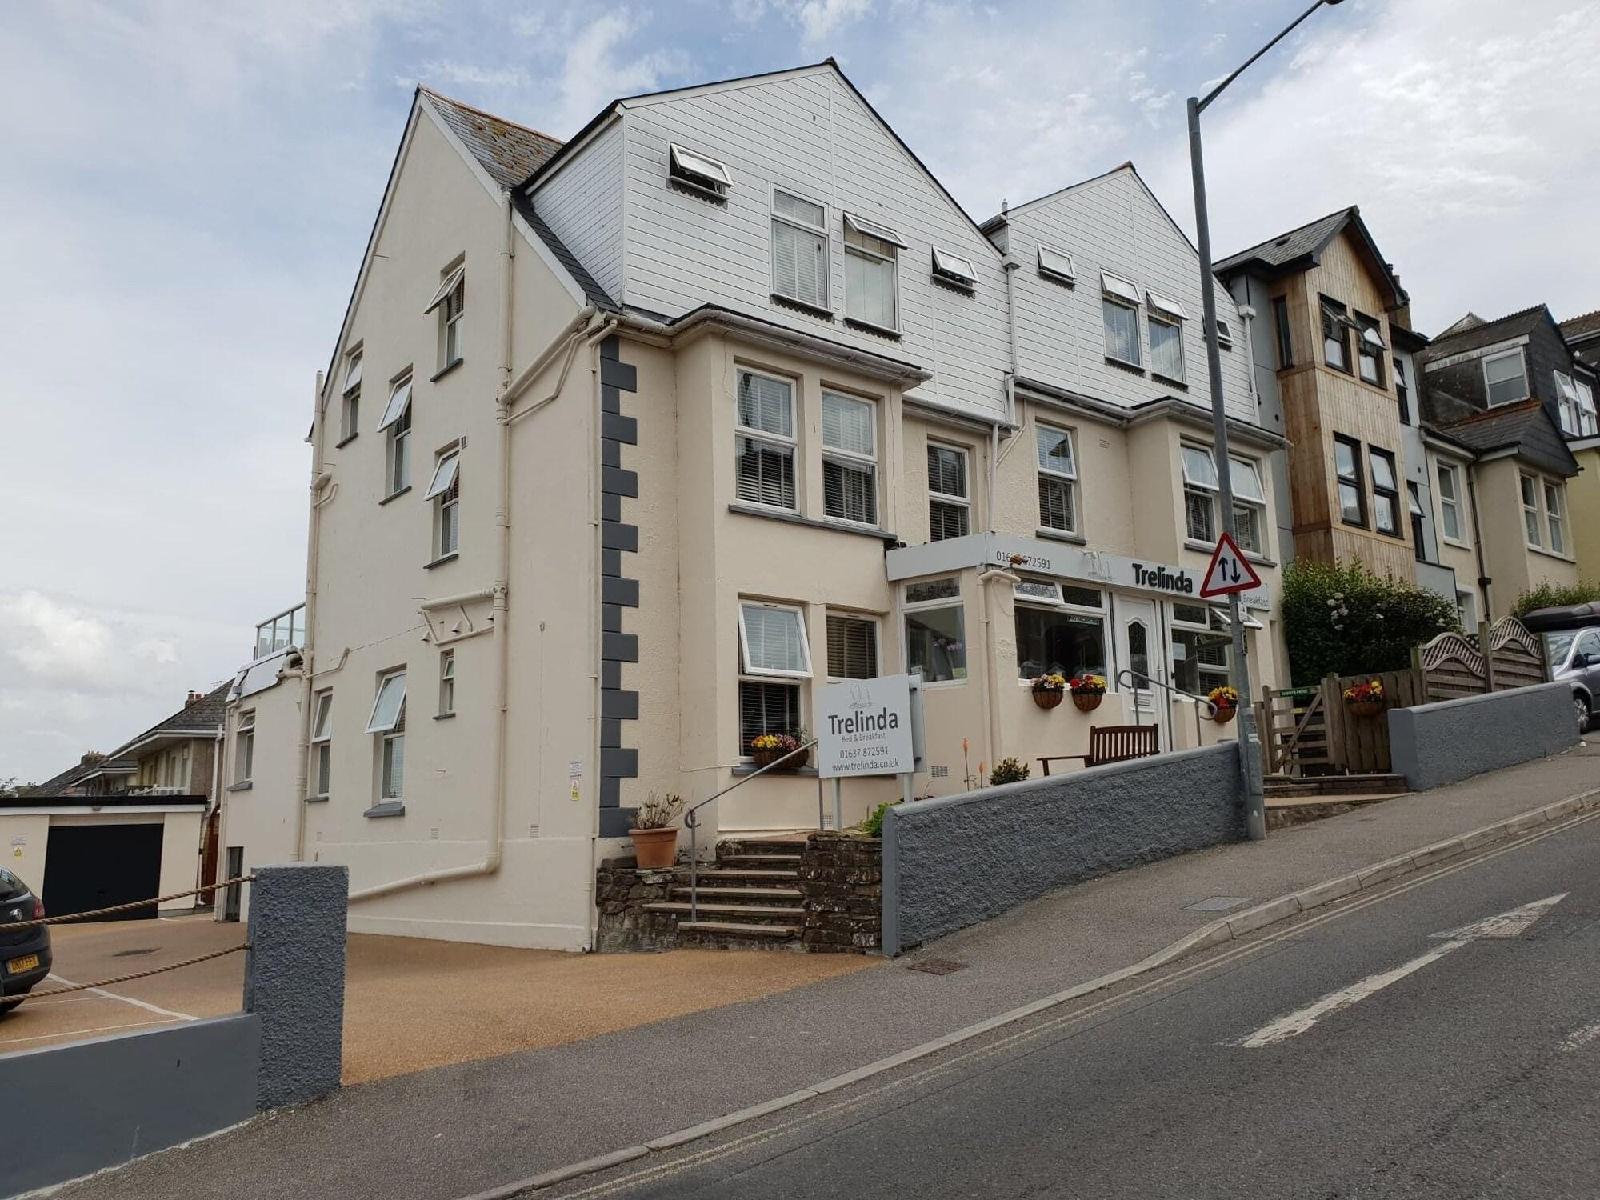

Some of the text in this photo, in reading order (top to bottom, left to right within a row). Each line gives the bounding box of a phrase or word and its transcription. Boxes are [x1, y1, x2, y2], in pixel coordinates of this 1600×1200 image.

[1132, 563, 1193, 593] Trelinda
[828, 707, 899, 735] Trelinda
[840, 746, 889, 759] 01637 872591
